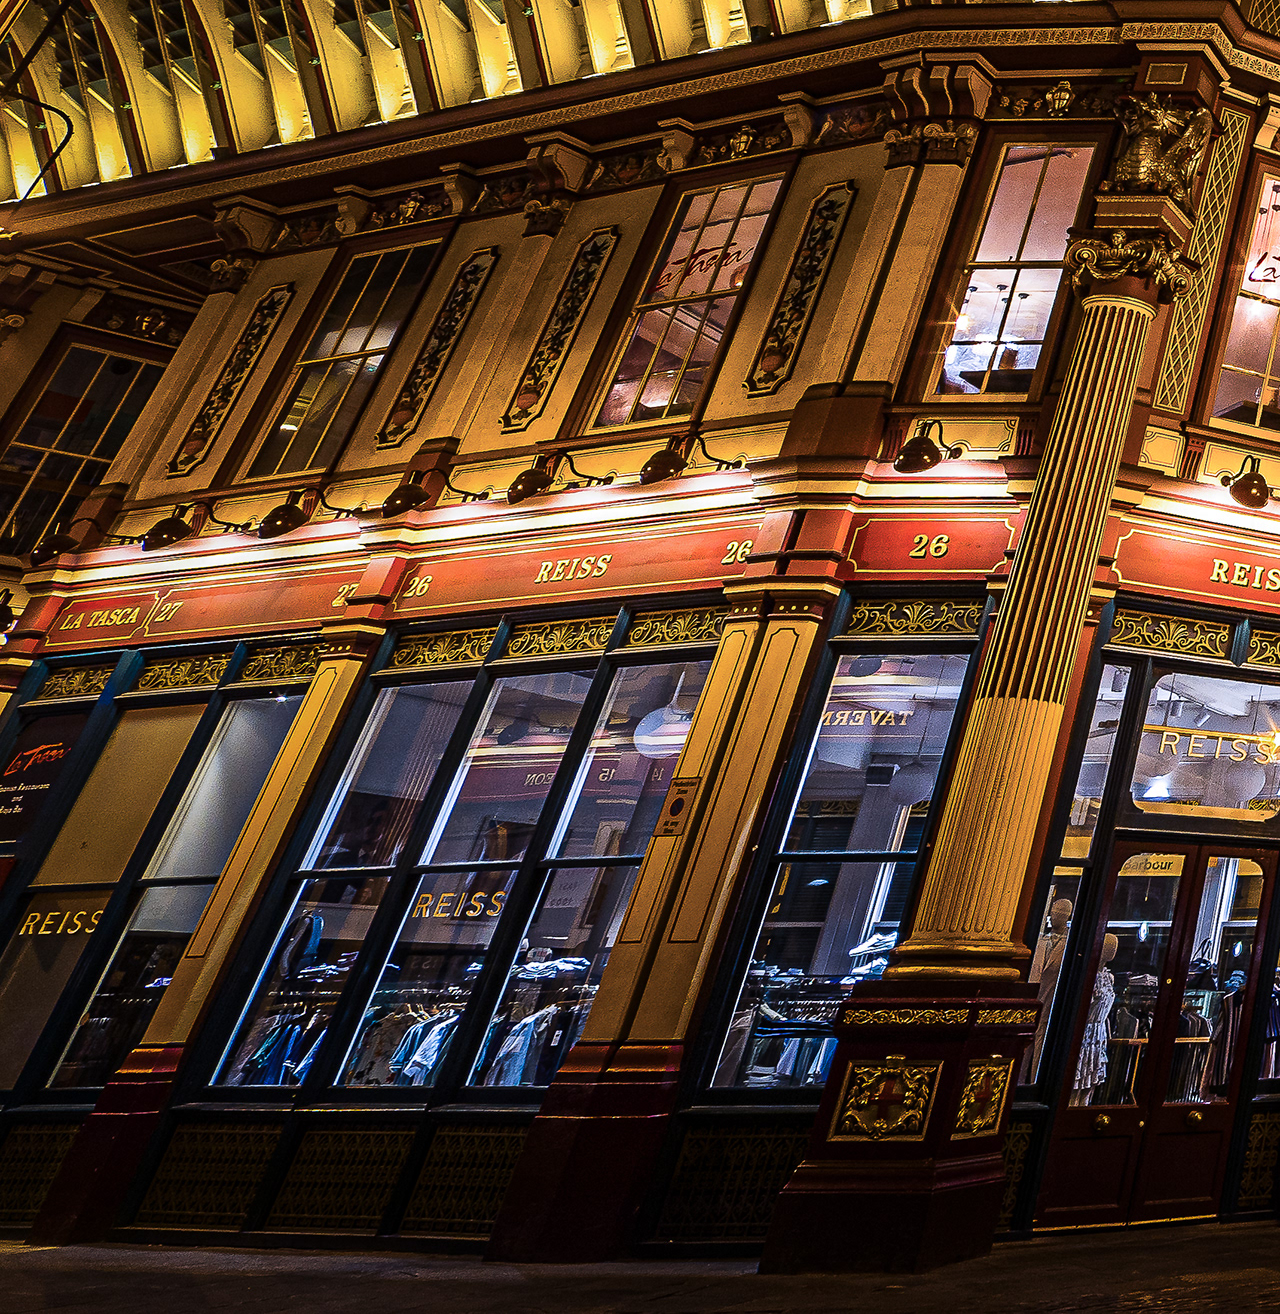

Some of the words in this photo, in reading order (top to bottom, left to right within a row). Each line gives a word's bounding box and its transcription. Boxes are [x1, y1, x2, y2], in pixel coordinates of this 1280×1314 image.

[721, 539, 753, 564] 26
[909, 534, 950, 559] 26
[534, 554, 613, 584] REISS
[402, 574, 433, 599] 26
[59, 611, 83, 631] LA
[87, 606, 141, 628] TASCA
[155, 601, 184, 623] 27
[1159, 731, 1274, 765] REISS
[411, 890, 506, 919] REISS
[19, 910, 103, 936] REISS
